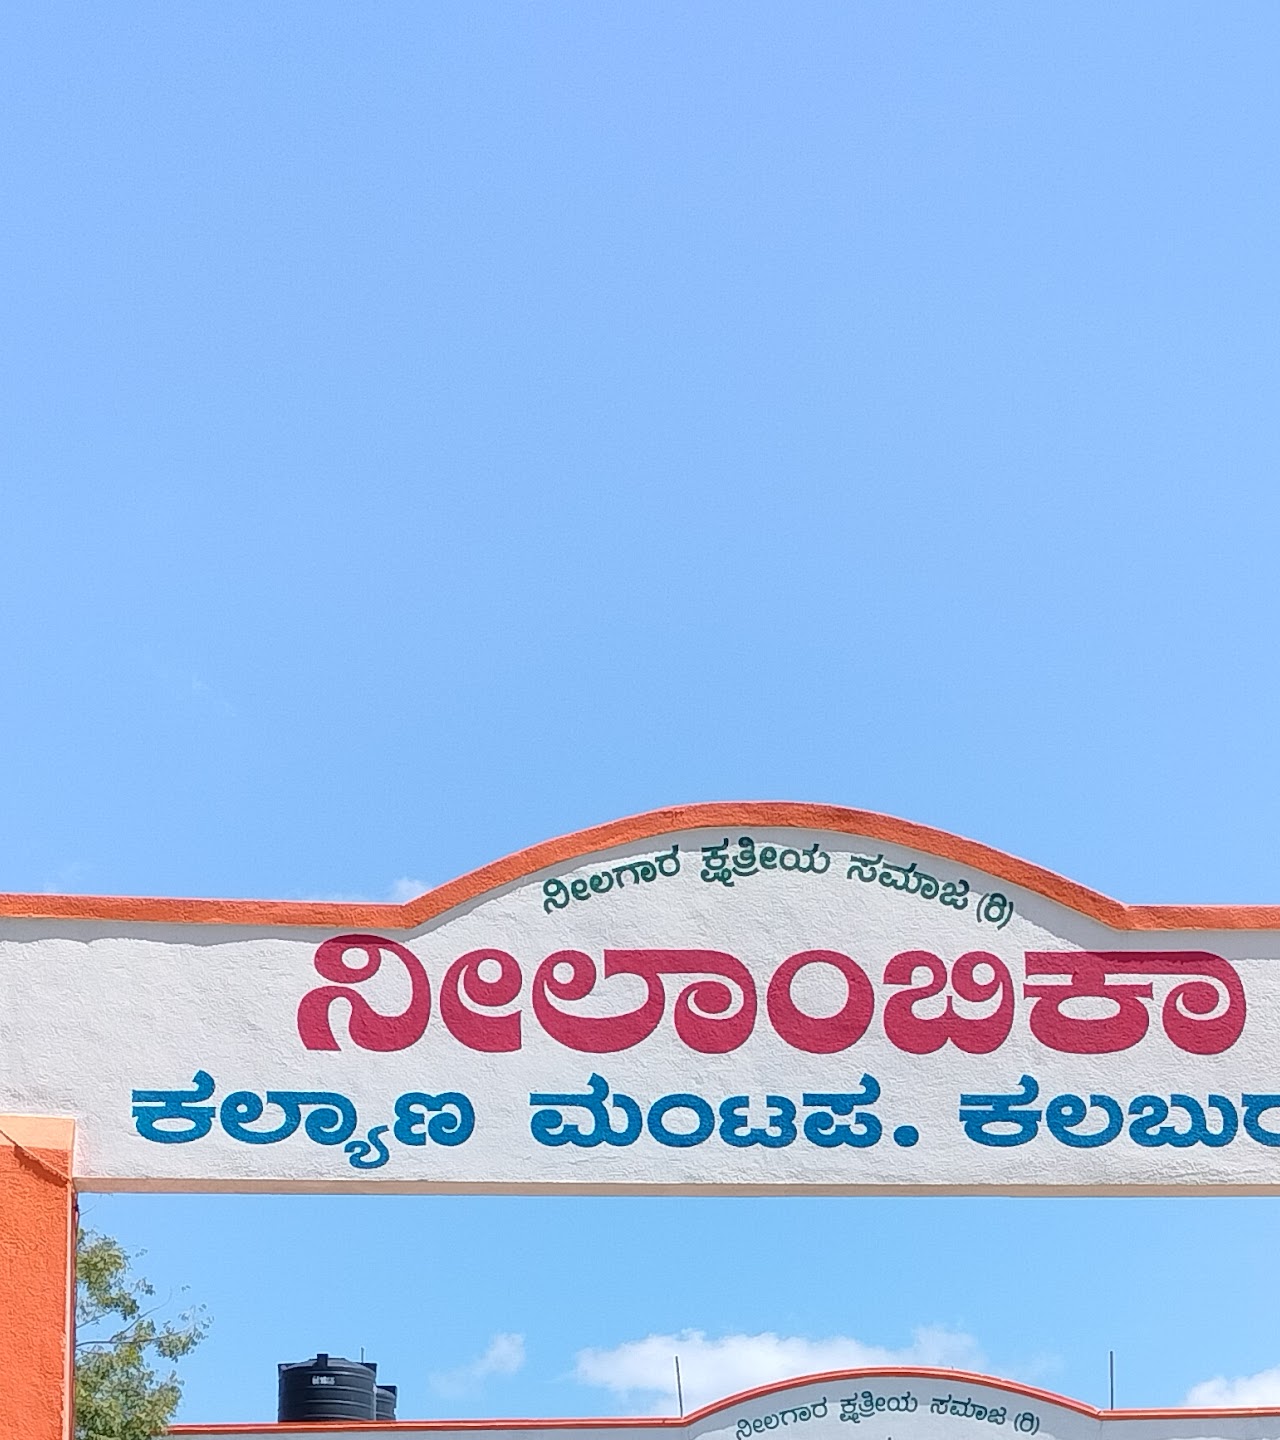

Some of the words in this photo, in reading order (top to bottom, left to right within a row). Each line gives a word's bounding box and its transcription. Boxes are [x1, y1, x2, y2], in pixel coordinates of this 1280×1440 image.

[544, 845, 680, 914] ನೀಲಗಾರ
[847, 854, 969, 910] ಸಮಾಜ
[298, 934, 1245, 1053] ನೀಲಾಂಬಿಕಾ
[131, 1070, 475, 1168] ಕಲ್ಯಾಣ
[529, 1072, 919, 1147] ಮಂಟಪ.
[735, 1397, 828, 1440] ನೀಲಗಾರ
[931, 1395, 1006, 1424] ಸಮಾಜ
